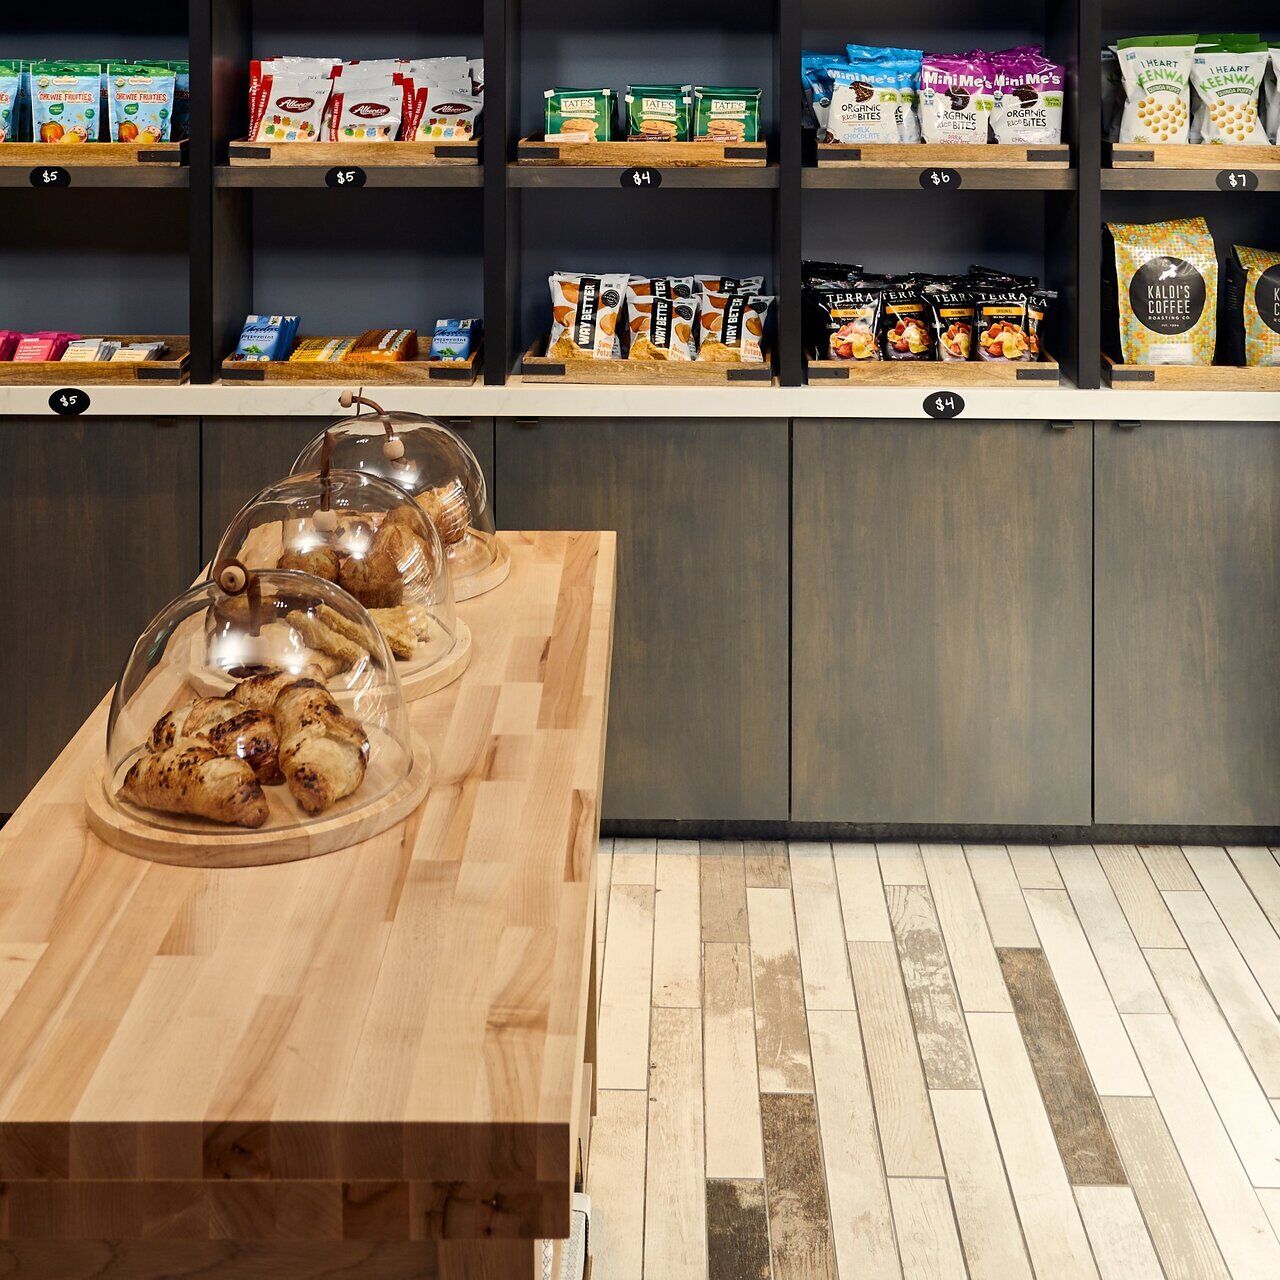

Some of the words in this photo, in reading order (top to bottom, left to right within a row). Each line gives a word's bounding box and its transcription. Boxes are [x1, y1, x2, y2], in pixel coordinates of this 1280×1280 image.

[1148, 59, 1178, 68] HEART
[1217, 65, 1250, 73] HEART
[925, 71, 957, 86] Mini
[959, 75, 993, 89] Me's
[1200, 74, 1255, 91] KEENWA
[39, 91, 63, 101] CHEWIE
[64, 92, 93, 102] FRUITIES
[645, 100, 674, 110] TATE'S
[43, 171, 57, 182] $5
[337, 171, 354, 184] $5
[633, 171, 650, 185] $4
[931, 173, 950, 186] $6
[1229, 174, 1246, 187] $7
[826, 292, 874, 303] TERRA
[978, 292, 1028, 301] TERRA
[1148, 285, 1190, 299] KALDI'S
[1148, 300, 1190, 314] COFFEE
[578, 325, 590, 345] WAY
[584, 284, 595, 322] BETTER
[726, 326, 736, 344] WAY
[60, 395, 77, 407] $5
[936, 397, 954, 411] $4
